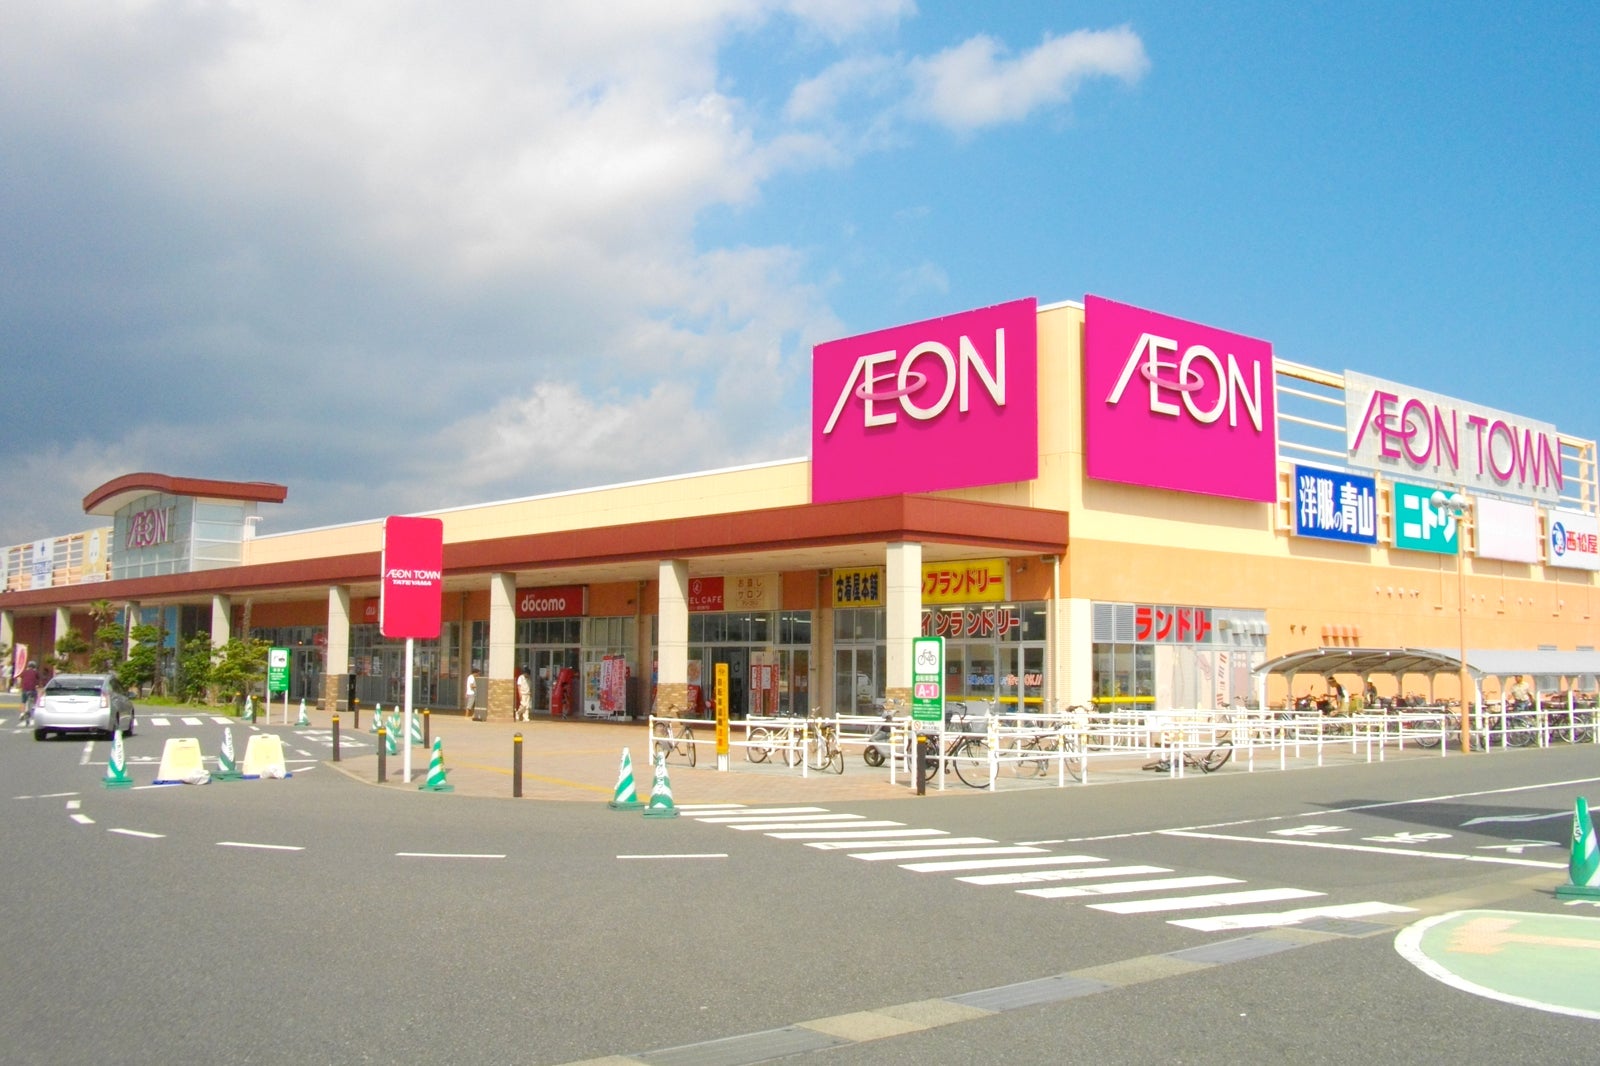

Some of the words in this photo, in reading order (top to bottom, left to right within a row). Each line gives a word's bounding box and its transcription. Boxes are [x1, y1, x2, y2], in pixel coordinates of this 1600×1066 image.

[1467, 414, 1563, 491] TOWN
[1299, 474, 1375, 537] 洋服の青山
[1403, 493, 1457, 543] ニトリ
[1565, 529, 1599, 554] 西松屋
[392, 579, 433, 587] TATEYAMA
[413, 569, 441, 580] TOWN
[521, 594, 566, 612] docomo
[701, 595, 723, 604] CAFE
[1135, 607, 1212, 642] ランドリー
[918, 685, 935, 697] A-1
